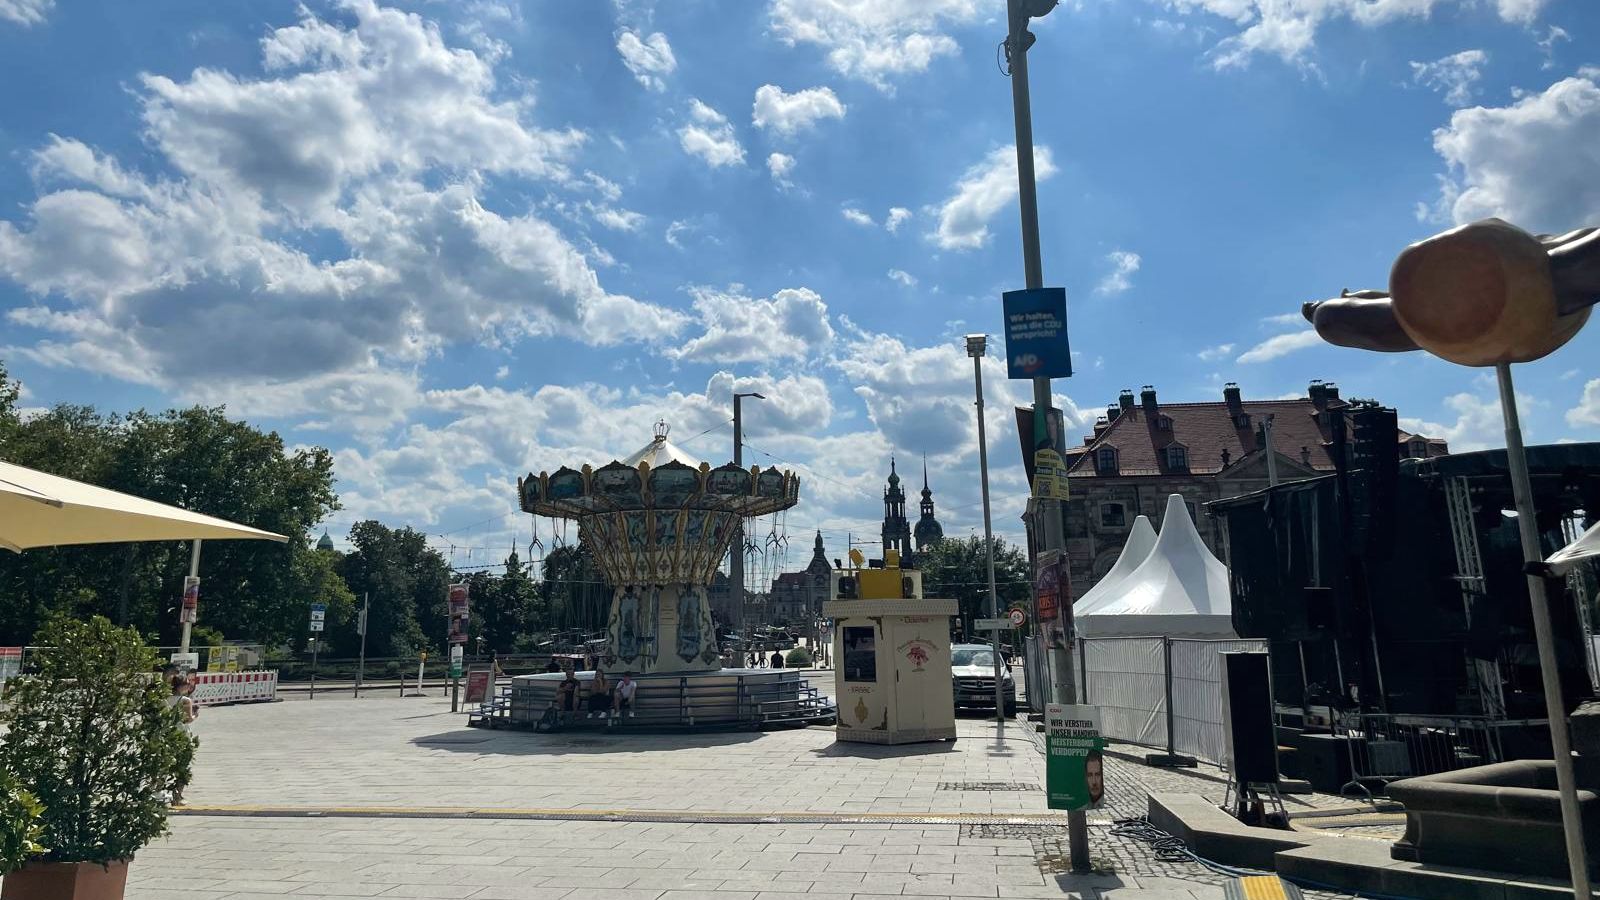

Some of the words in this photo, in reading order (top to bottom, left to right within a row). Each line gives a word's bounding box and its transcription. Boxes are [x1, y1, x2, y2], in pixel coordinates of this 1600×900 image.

[1009, 313, 1024, 322] Wir
[1010, 323, 1028, 331] was
[1029, 321, 1043, 330] die
[1044, 320, 1062, 329] CDU
[1014, 353, 1038, 367] AfD
[1050, 719, 1063, 727] WIR
[1050, 729, 1071, 738] UNSER
